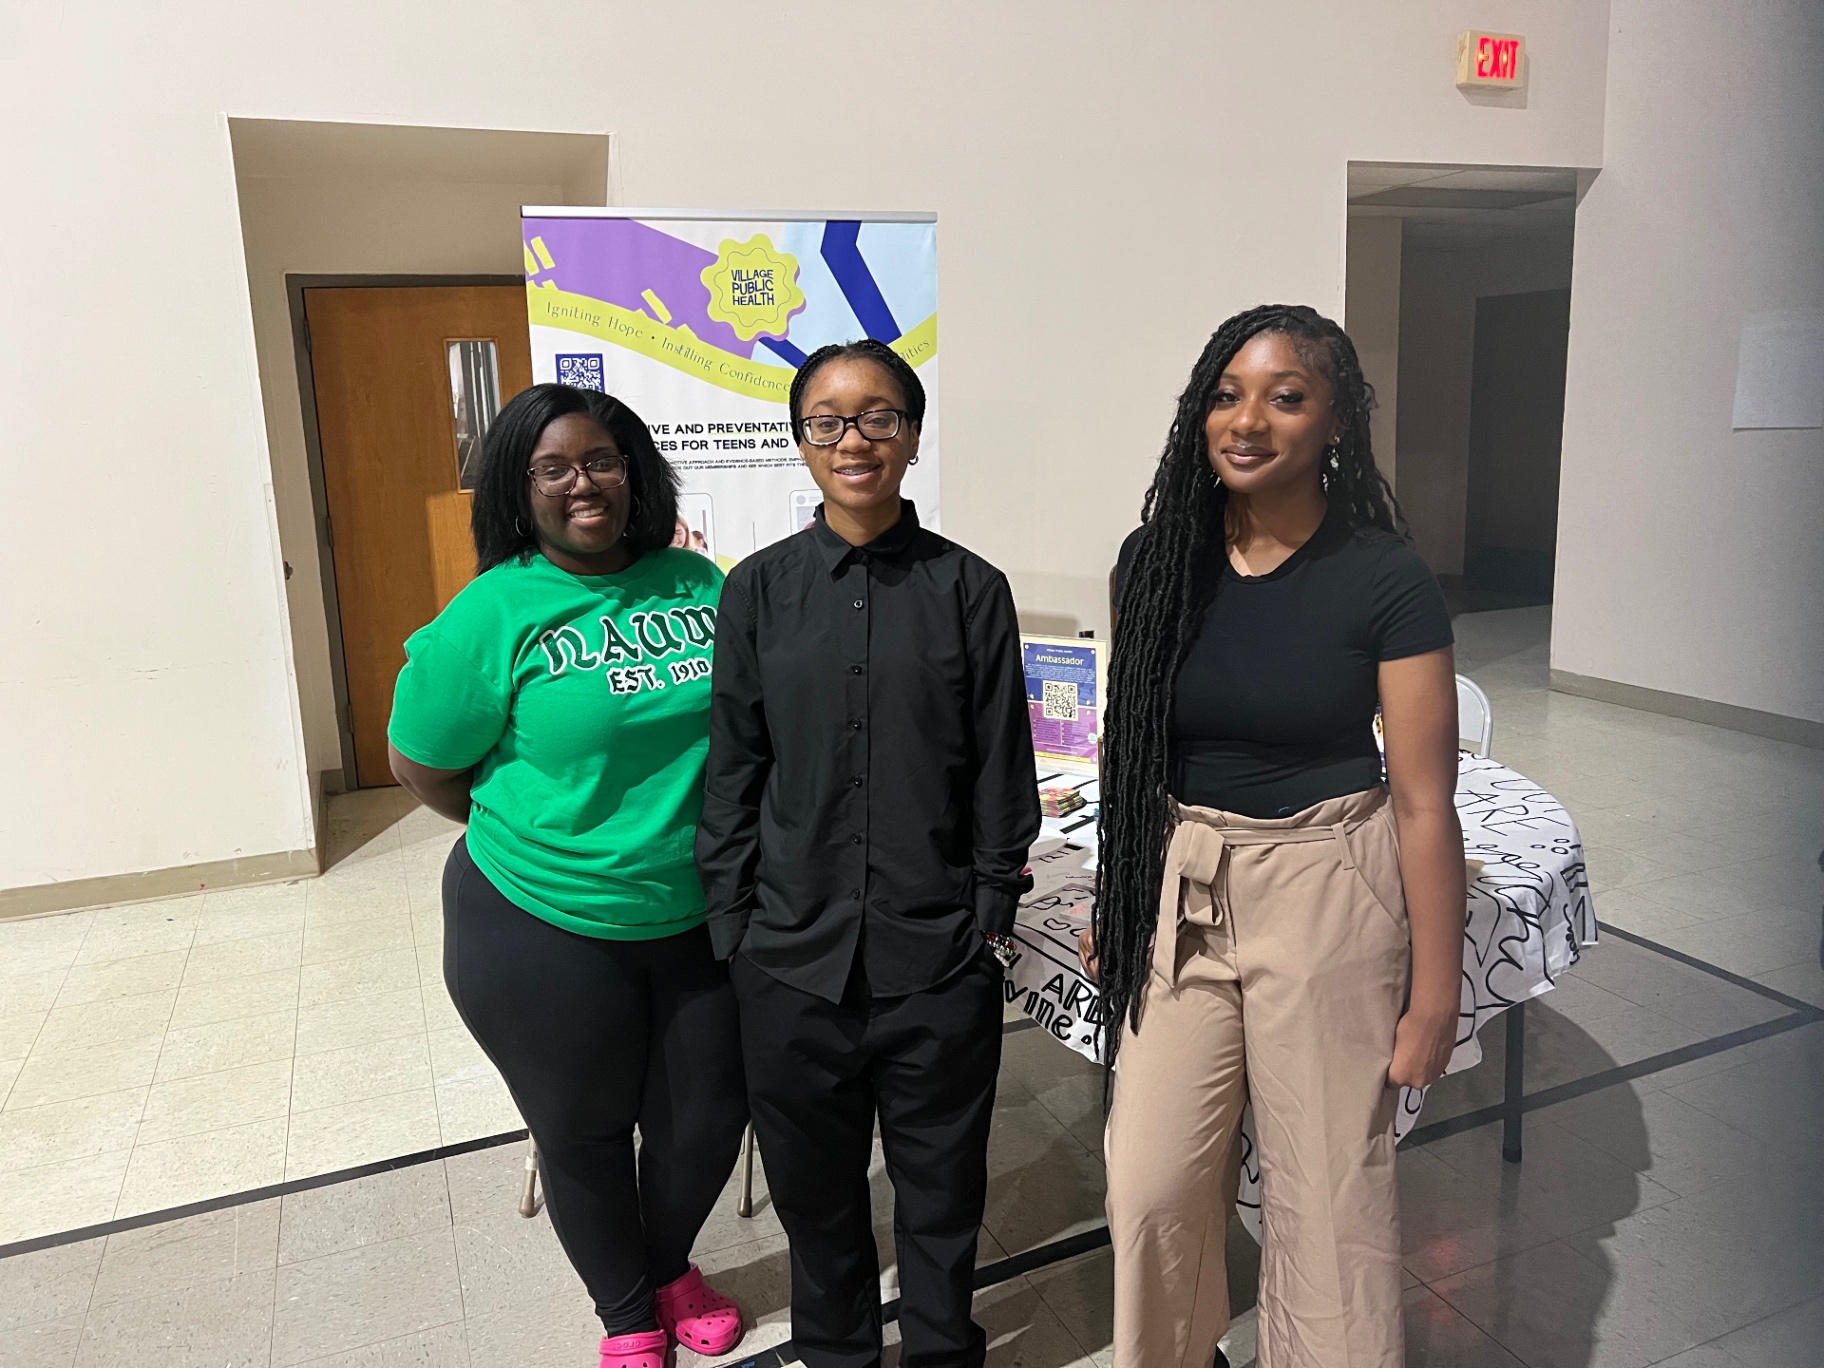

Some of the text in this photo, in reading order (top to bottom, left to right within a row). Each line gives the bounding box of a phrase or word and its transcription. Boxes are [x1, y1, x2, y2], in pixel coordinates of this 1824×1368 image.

[1477, 36, 1520, 80] EXIT
[731, 269, 774, 282] VILLAGE
[732, 279, 774, 295] PUBLIC
[732, 292, 775, 306] HEALTH
[547, 302, 601, 327] Igniting
[608, 316, 643, 338] Hope
[661, 337, 713, 371] Instilling
[719, 362, 791, 392] Confidence
[674, 424, 704, 434] AND
[708, 422, 792, 433] PREVENTATI
[681, 440, 709, 451] FOR
[713, 439, 756, 450] TEENS
[760, 438, 789, 449] AND
[1035, 654, 1084, 666] Ambassador
[608, 659, 711, 693] EST. 1910
